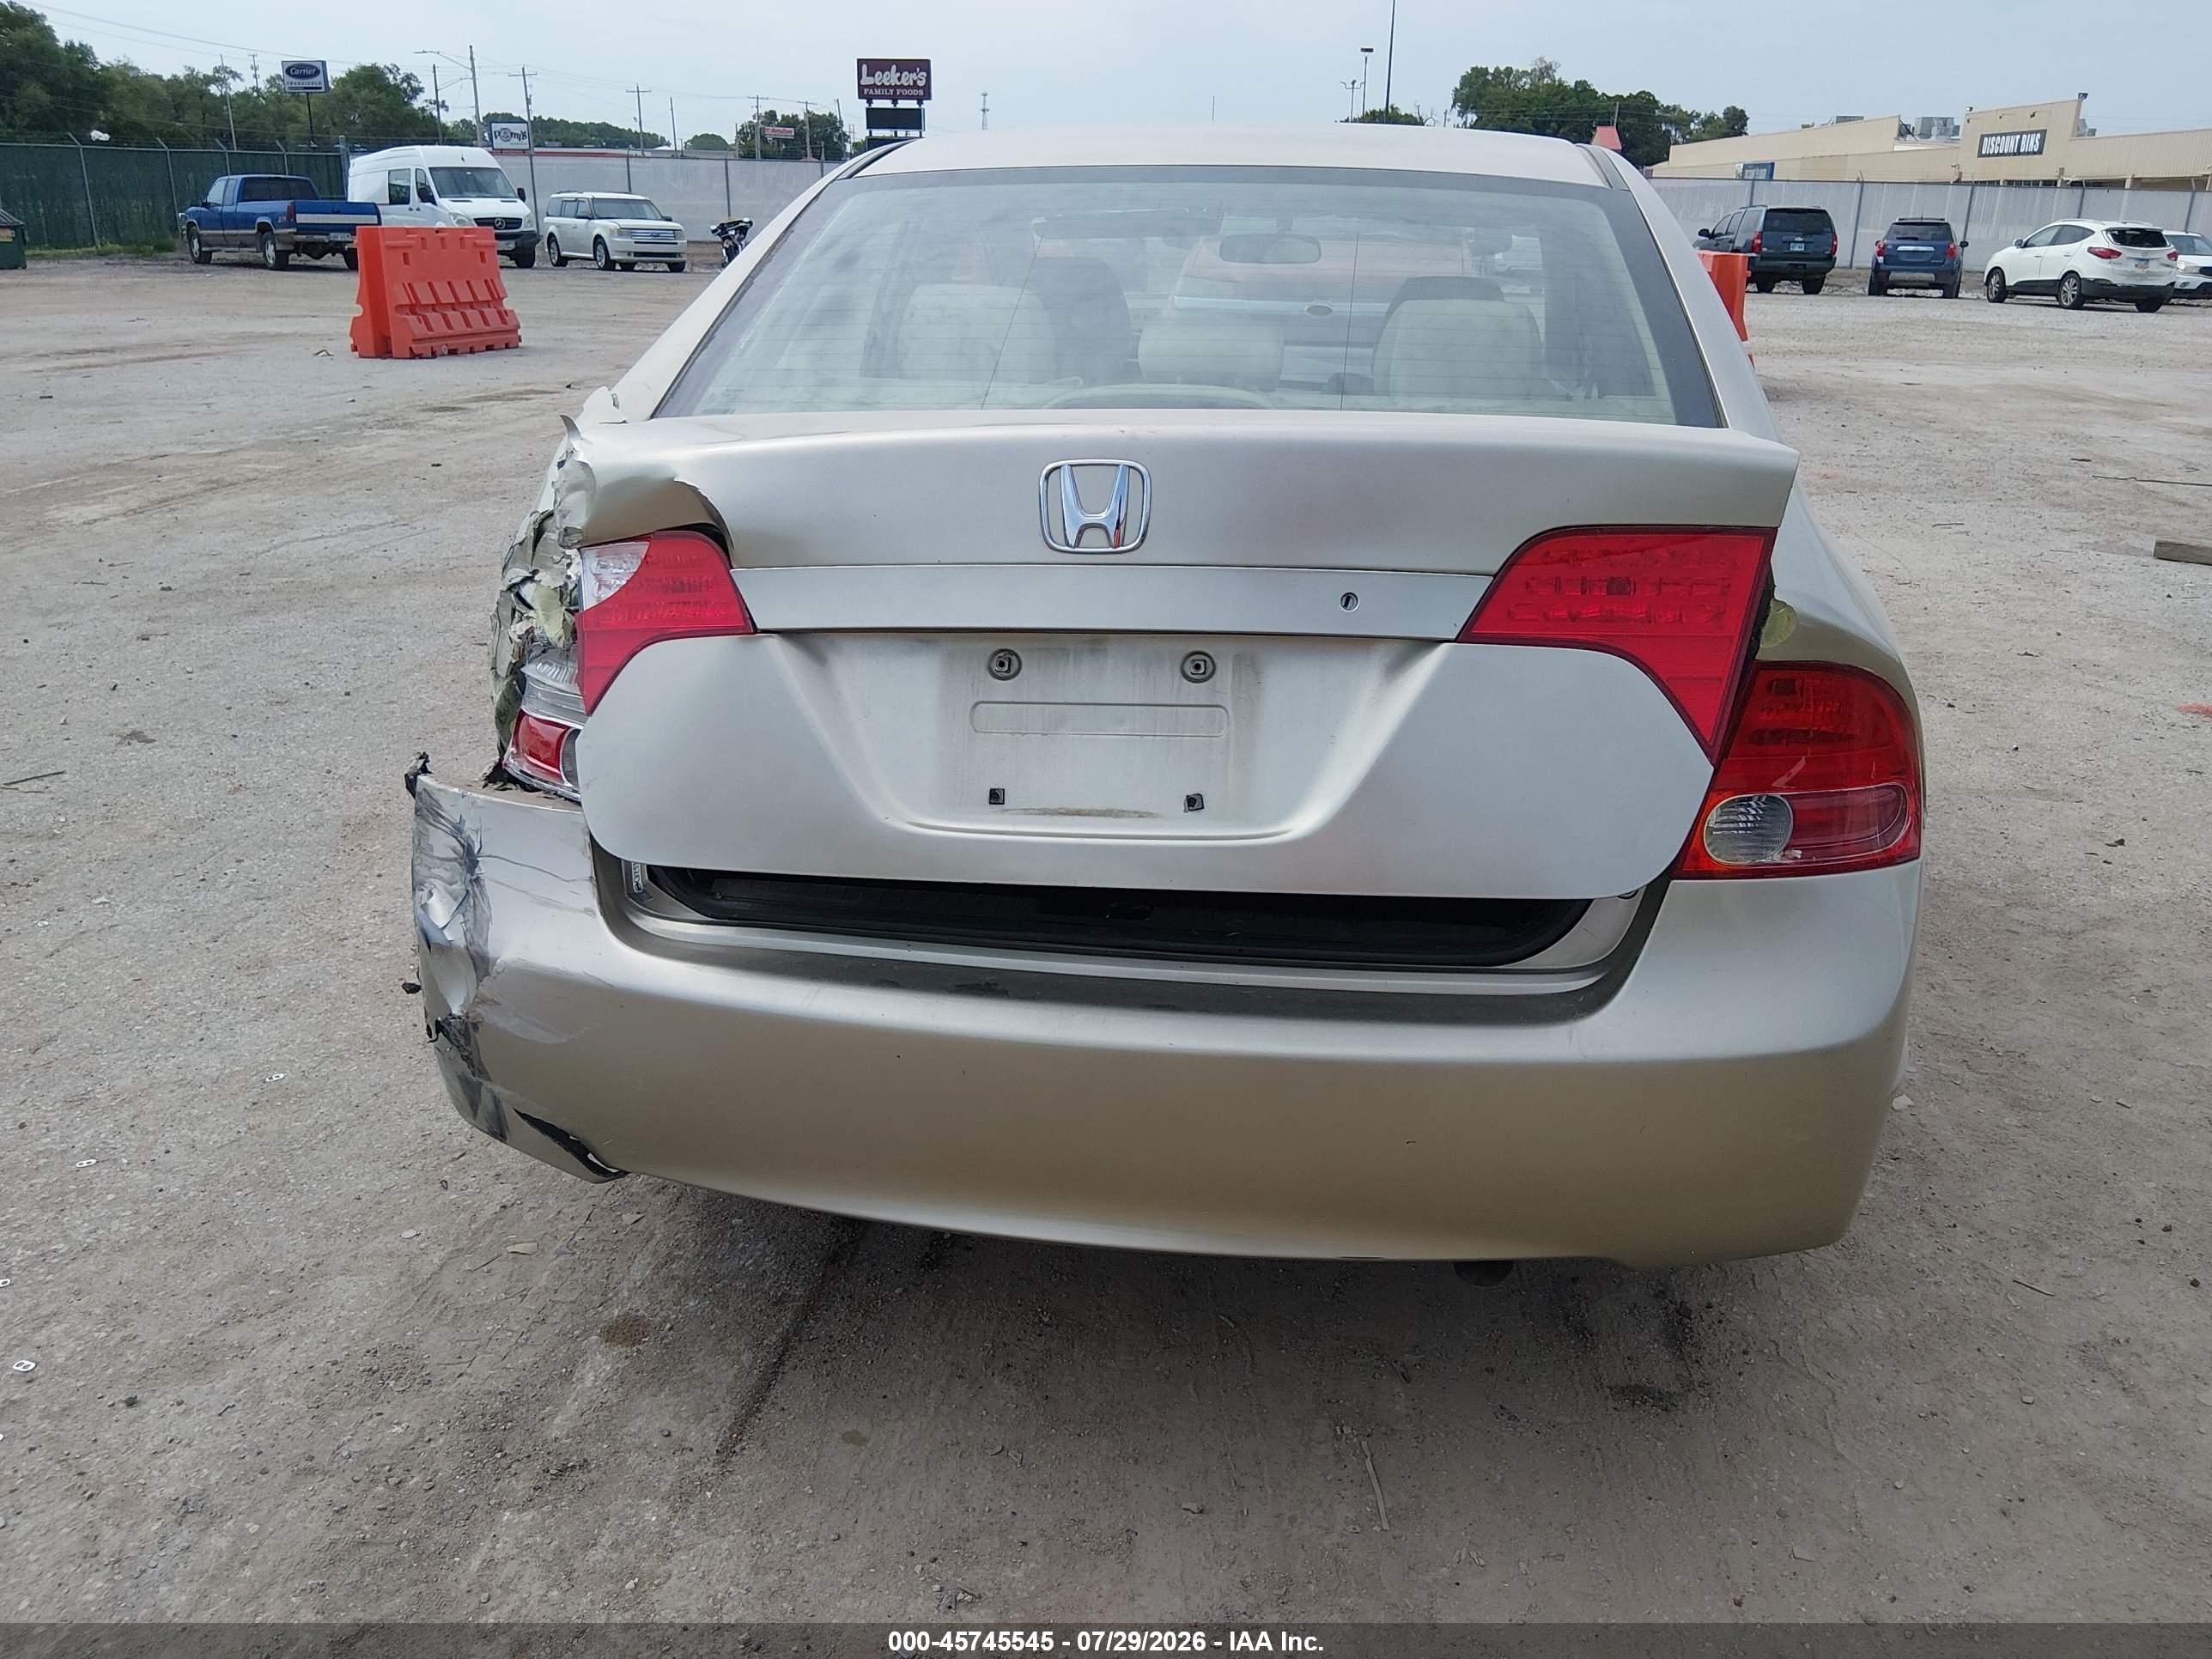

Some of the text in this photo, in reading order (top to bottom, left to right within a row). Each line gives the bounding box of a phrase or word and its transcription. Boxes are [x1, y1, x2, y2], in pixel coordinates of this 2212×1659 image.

[289, 67, 317, 76] Carrier
[860, 64, 927, 87] Leeker's
[1981, 132, 2041, 155] DISCOUNT BINS
